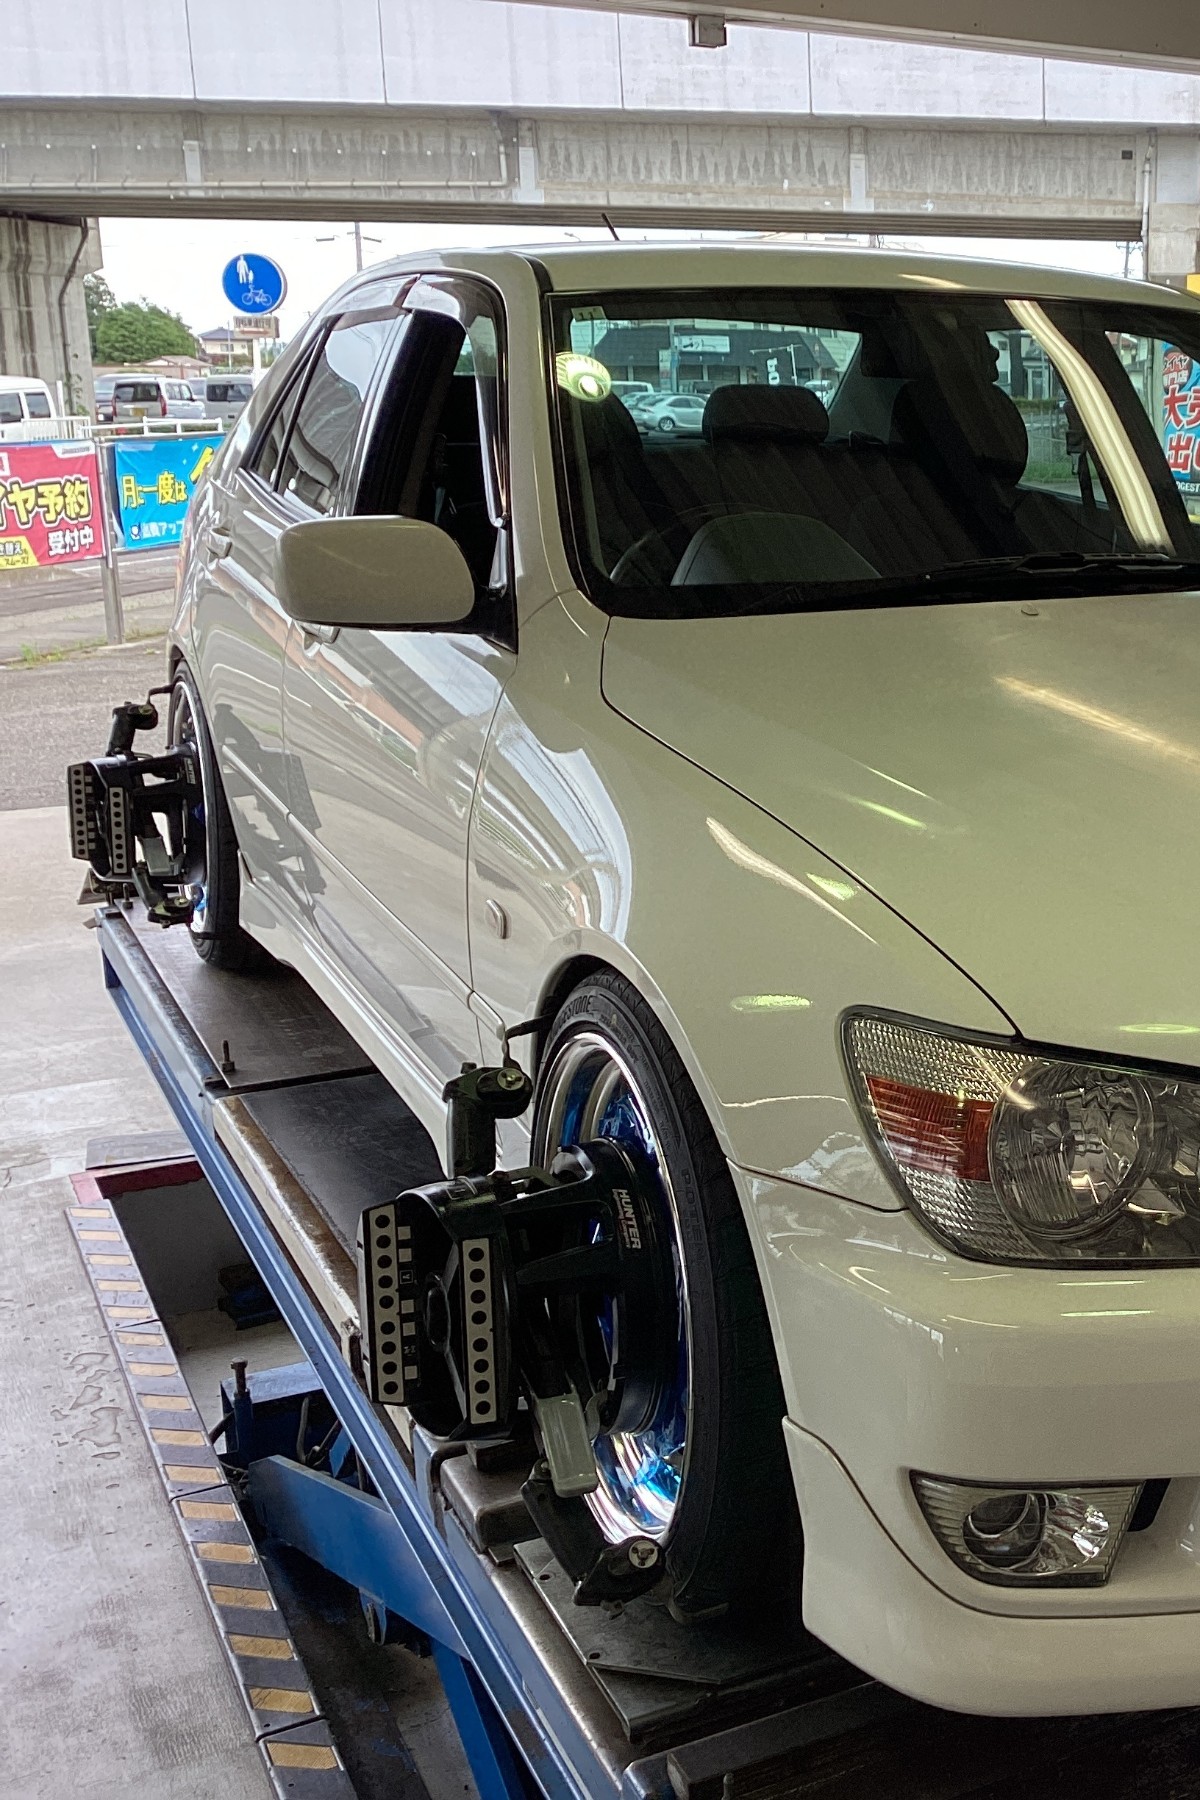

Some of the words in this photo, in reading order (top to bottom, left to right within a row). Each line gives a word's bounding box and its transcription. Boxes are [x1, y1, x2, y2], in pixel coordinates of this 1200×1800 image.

[0, 477, 91, 526] ヤ予約
[48, 526, 94, 556] 受付中
[619, 1188, 642, 1250] HUNTER
